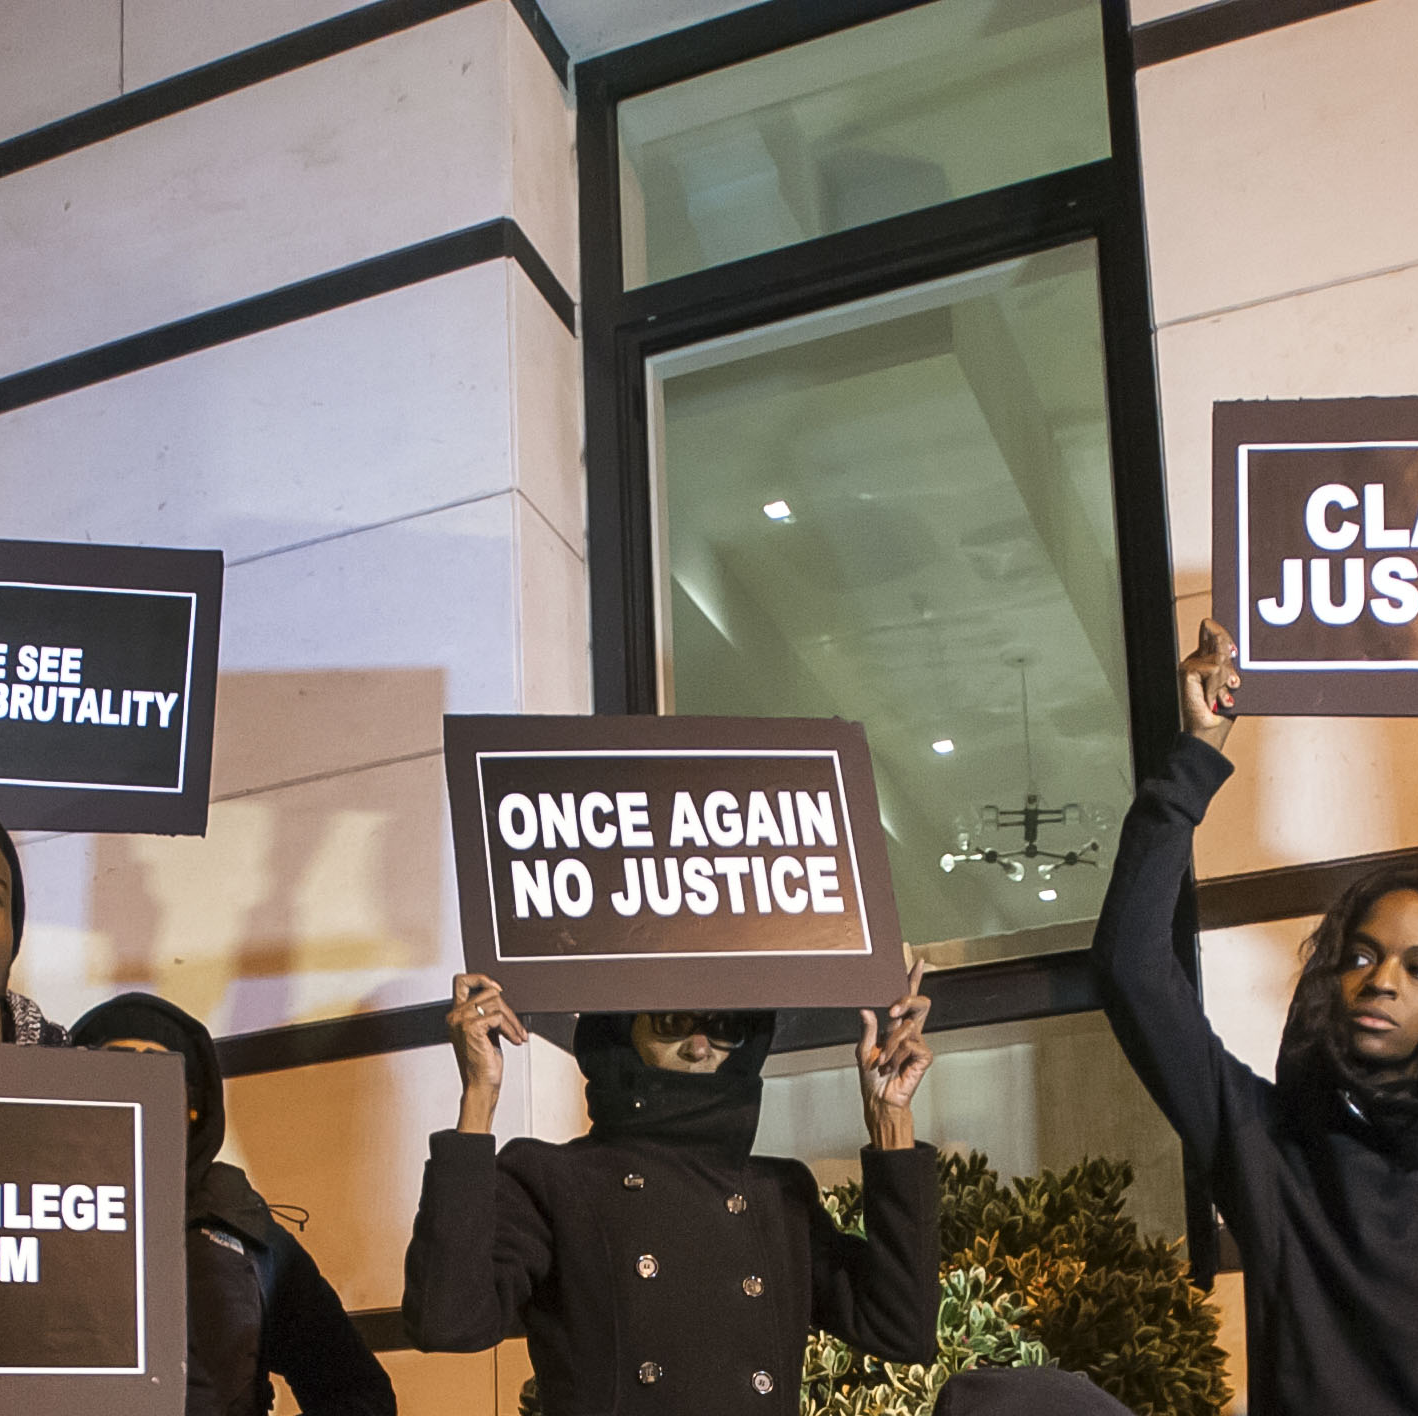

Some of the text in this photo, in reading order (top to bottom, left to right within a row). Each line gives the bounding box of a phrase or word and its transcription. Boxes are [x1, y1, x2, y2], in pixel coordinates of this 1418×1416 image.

[16, 645, 83, 684] SEE
[498, 790, 838, 850] ONCE AGAIN
[511, 855, 845, 918] NO JUSTICE
